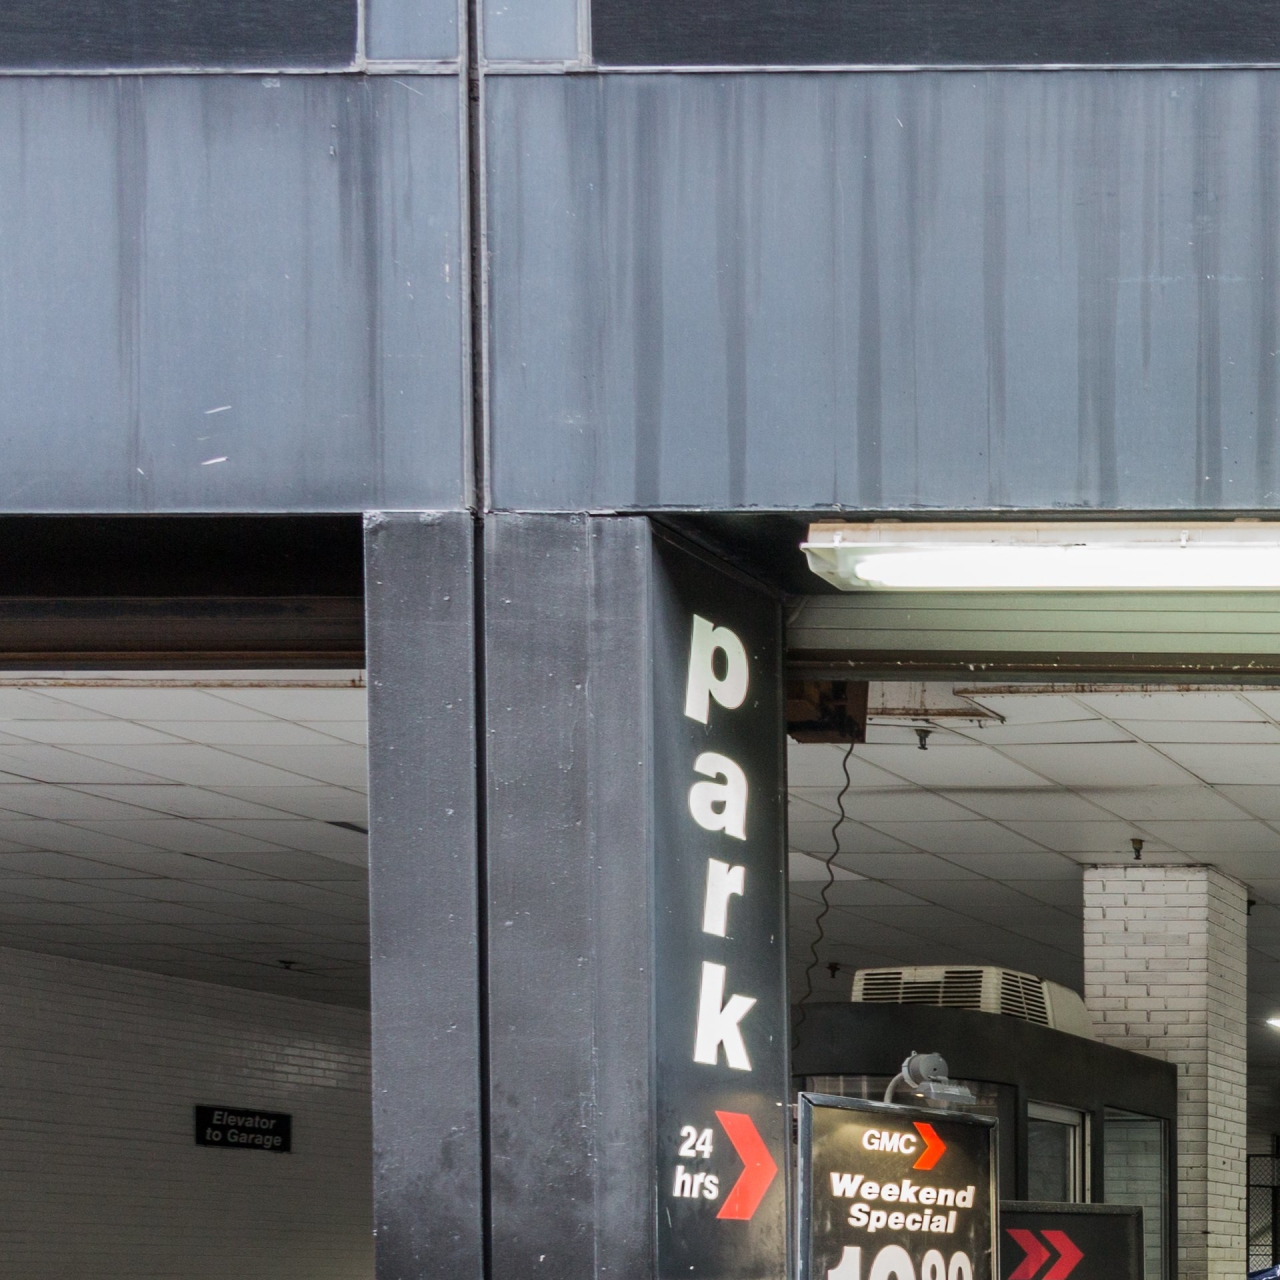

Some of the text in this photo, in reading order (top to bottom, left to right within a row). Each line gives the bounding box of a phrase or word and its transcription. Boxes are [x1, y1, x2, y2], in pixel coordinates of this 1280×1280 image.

[685, 613, 756, 1071] park
[212, 1111, 276, 1129] Elevator
[206, 1127, 282, 1149] to Garage
[678, 1125, 713, 1158] 24
[862, 1129, 917, 1154] GMC
[673, 1165, 719, 1200] hrs
[830, 1172, 975, 1208] Weekend
[848, 1203, 957, 1234] Special
